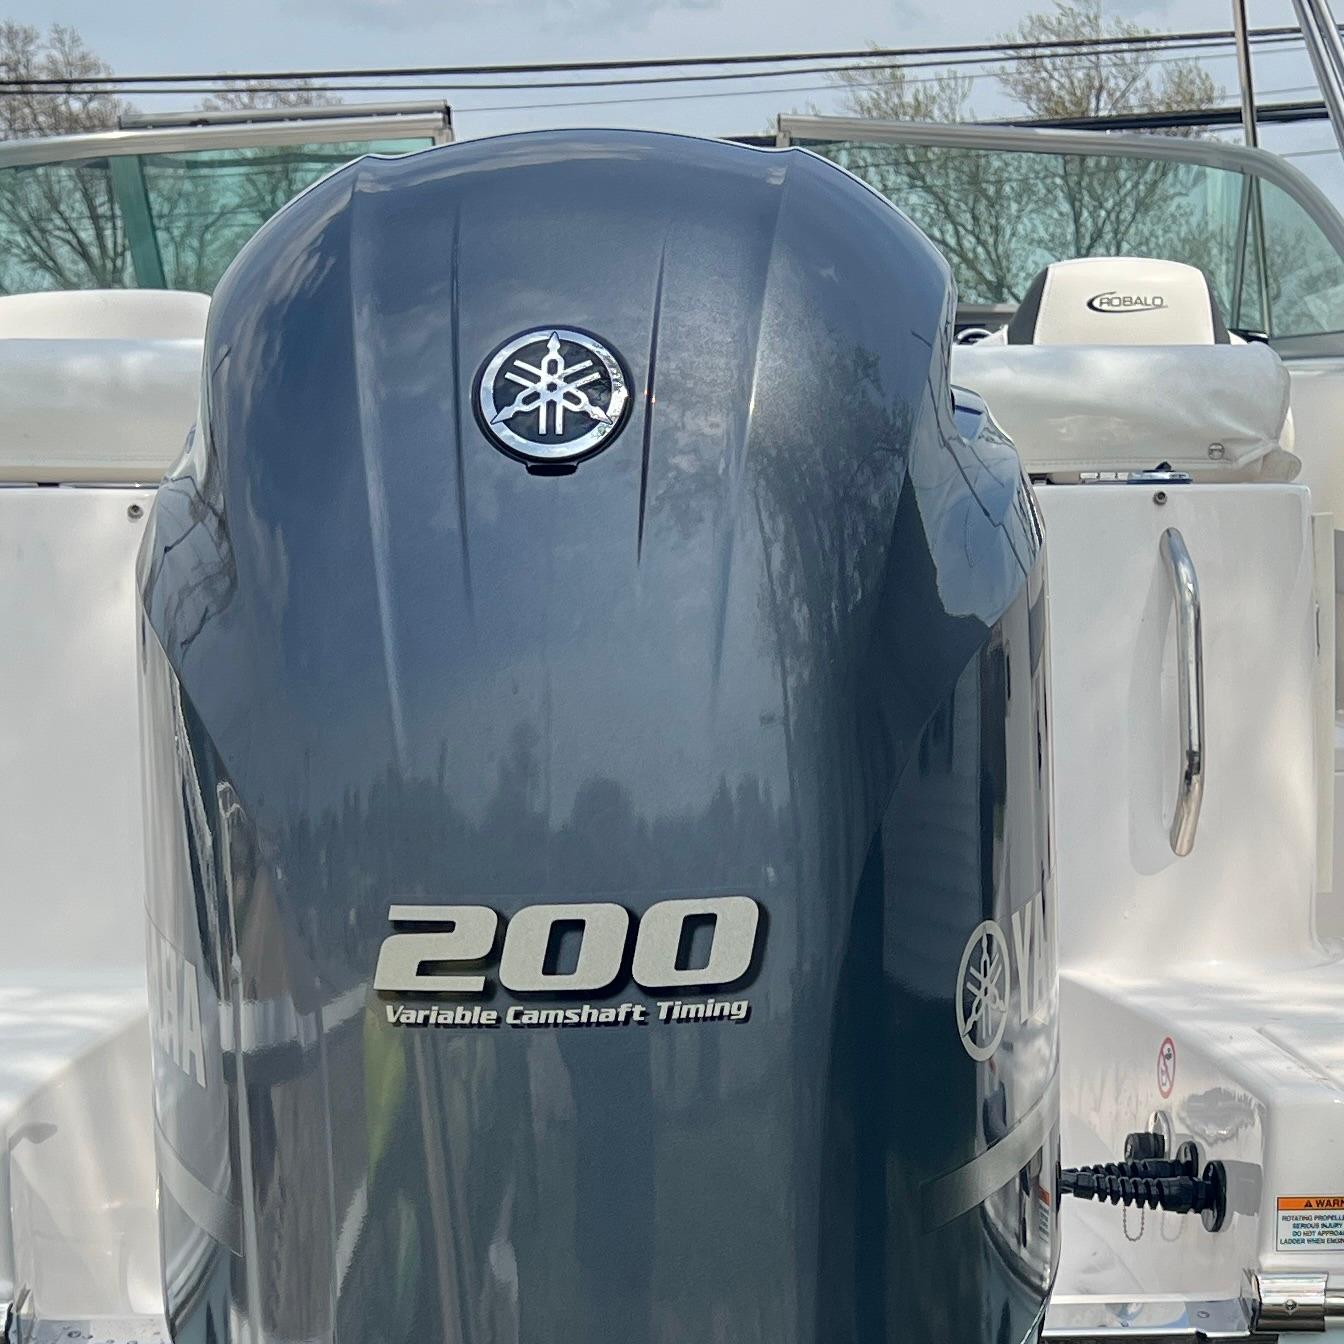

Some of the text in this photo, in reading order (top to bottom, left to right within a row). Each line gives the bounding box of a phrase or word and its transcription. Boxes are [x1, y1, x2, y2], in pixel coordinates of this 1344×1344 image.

[1098, 296, 1164, 307] ROBALO
[373, 895, 759, 992] 200
[386, 999, 749, 1026] Variable Camshaft Timing
